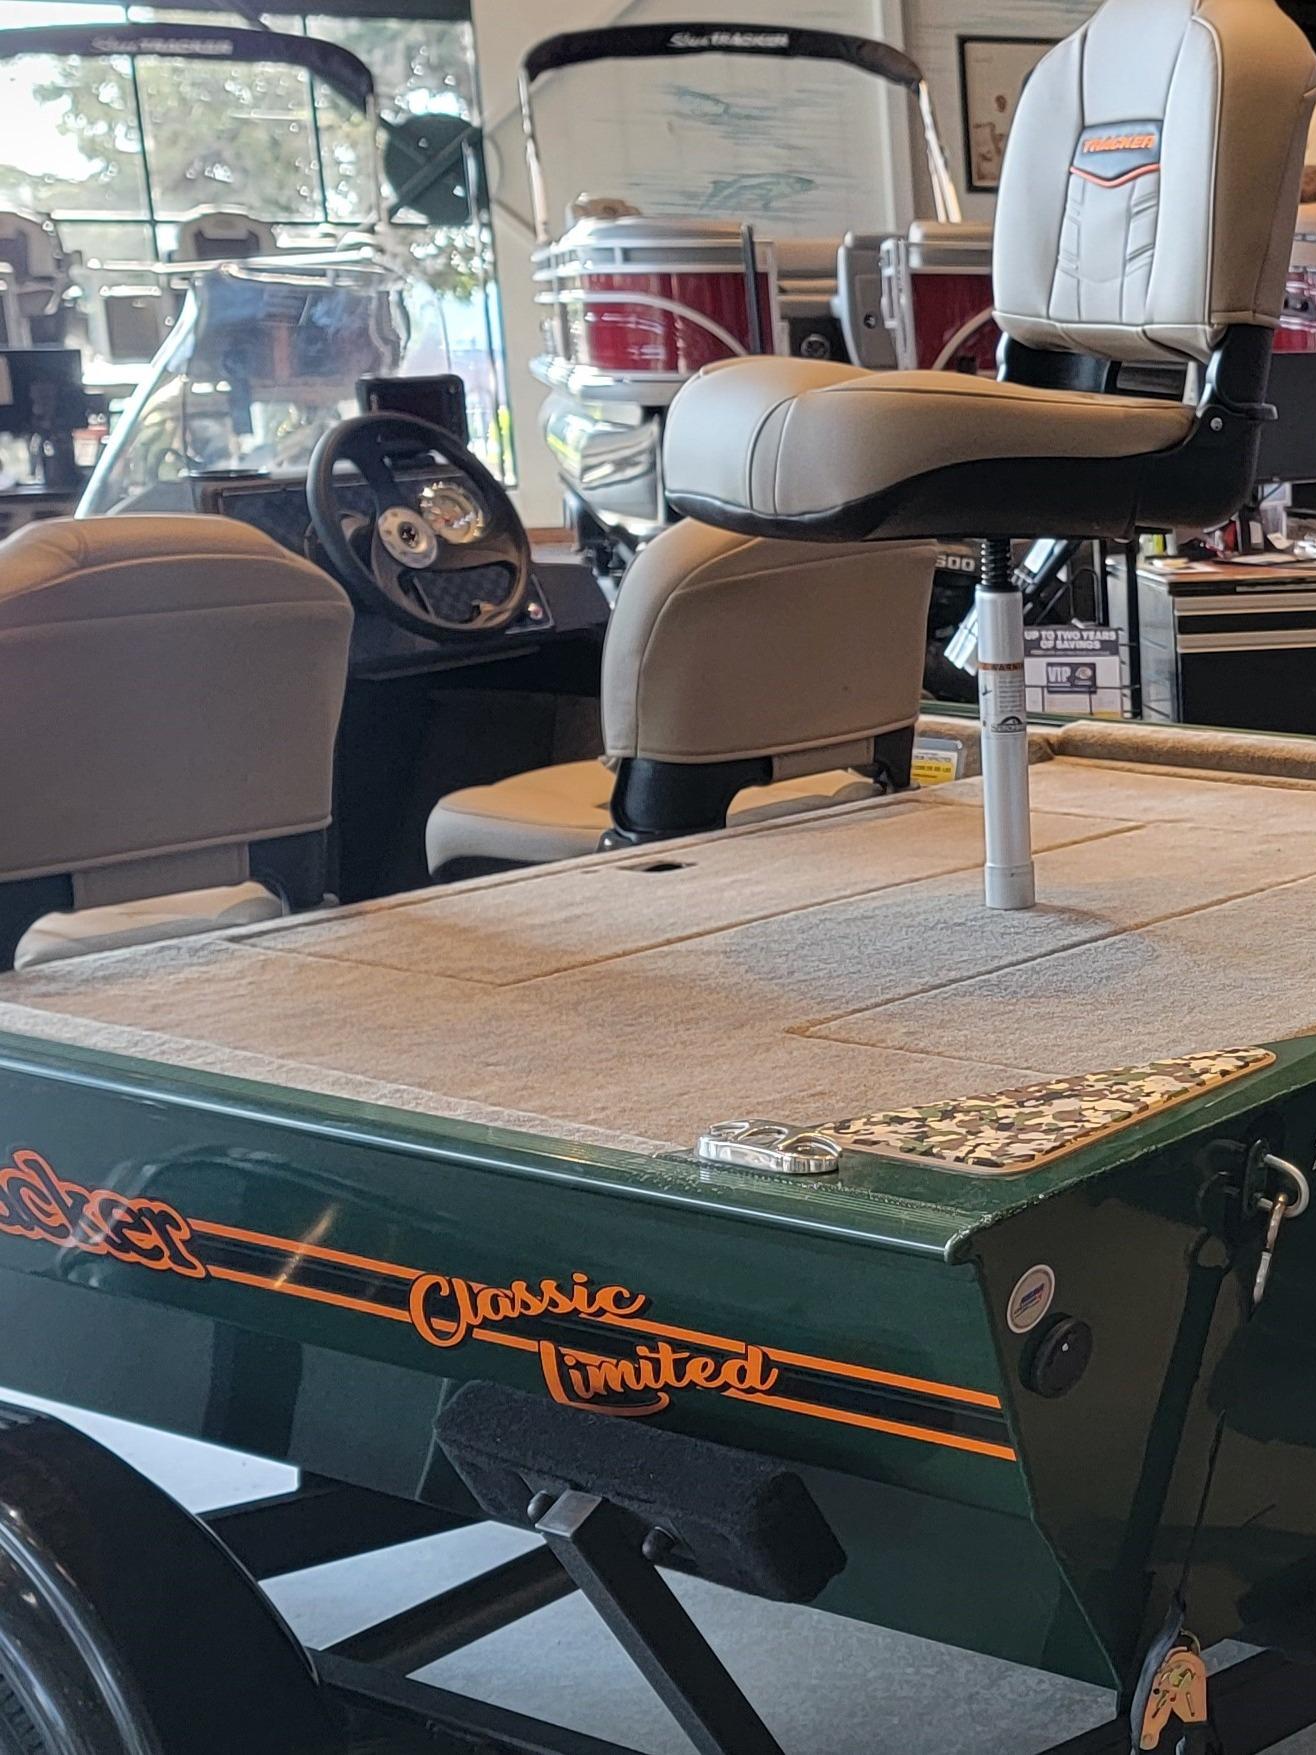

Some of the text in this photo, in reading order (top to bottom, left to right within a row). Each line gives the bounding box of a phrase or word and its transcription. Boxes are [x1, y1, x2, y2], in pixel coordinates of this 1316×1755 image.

[1082, 133, 1156, 153] TRACKER
[1024, 630, 1117, 641] UP TO TWO YEARS
[1040, 640, 1101, 650] OF SAVINGS
[1047, 666, 1072, 682] VIP
[409, 1272, 646, 1348] Classic
[537, 1340, 779, 1416] Limited
